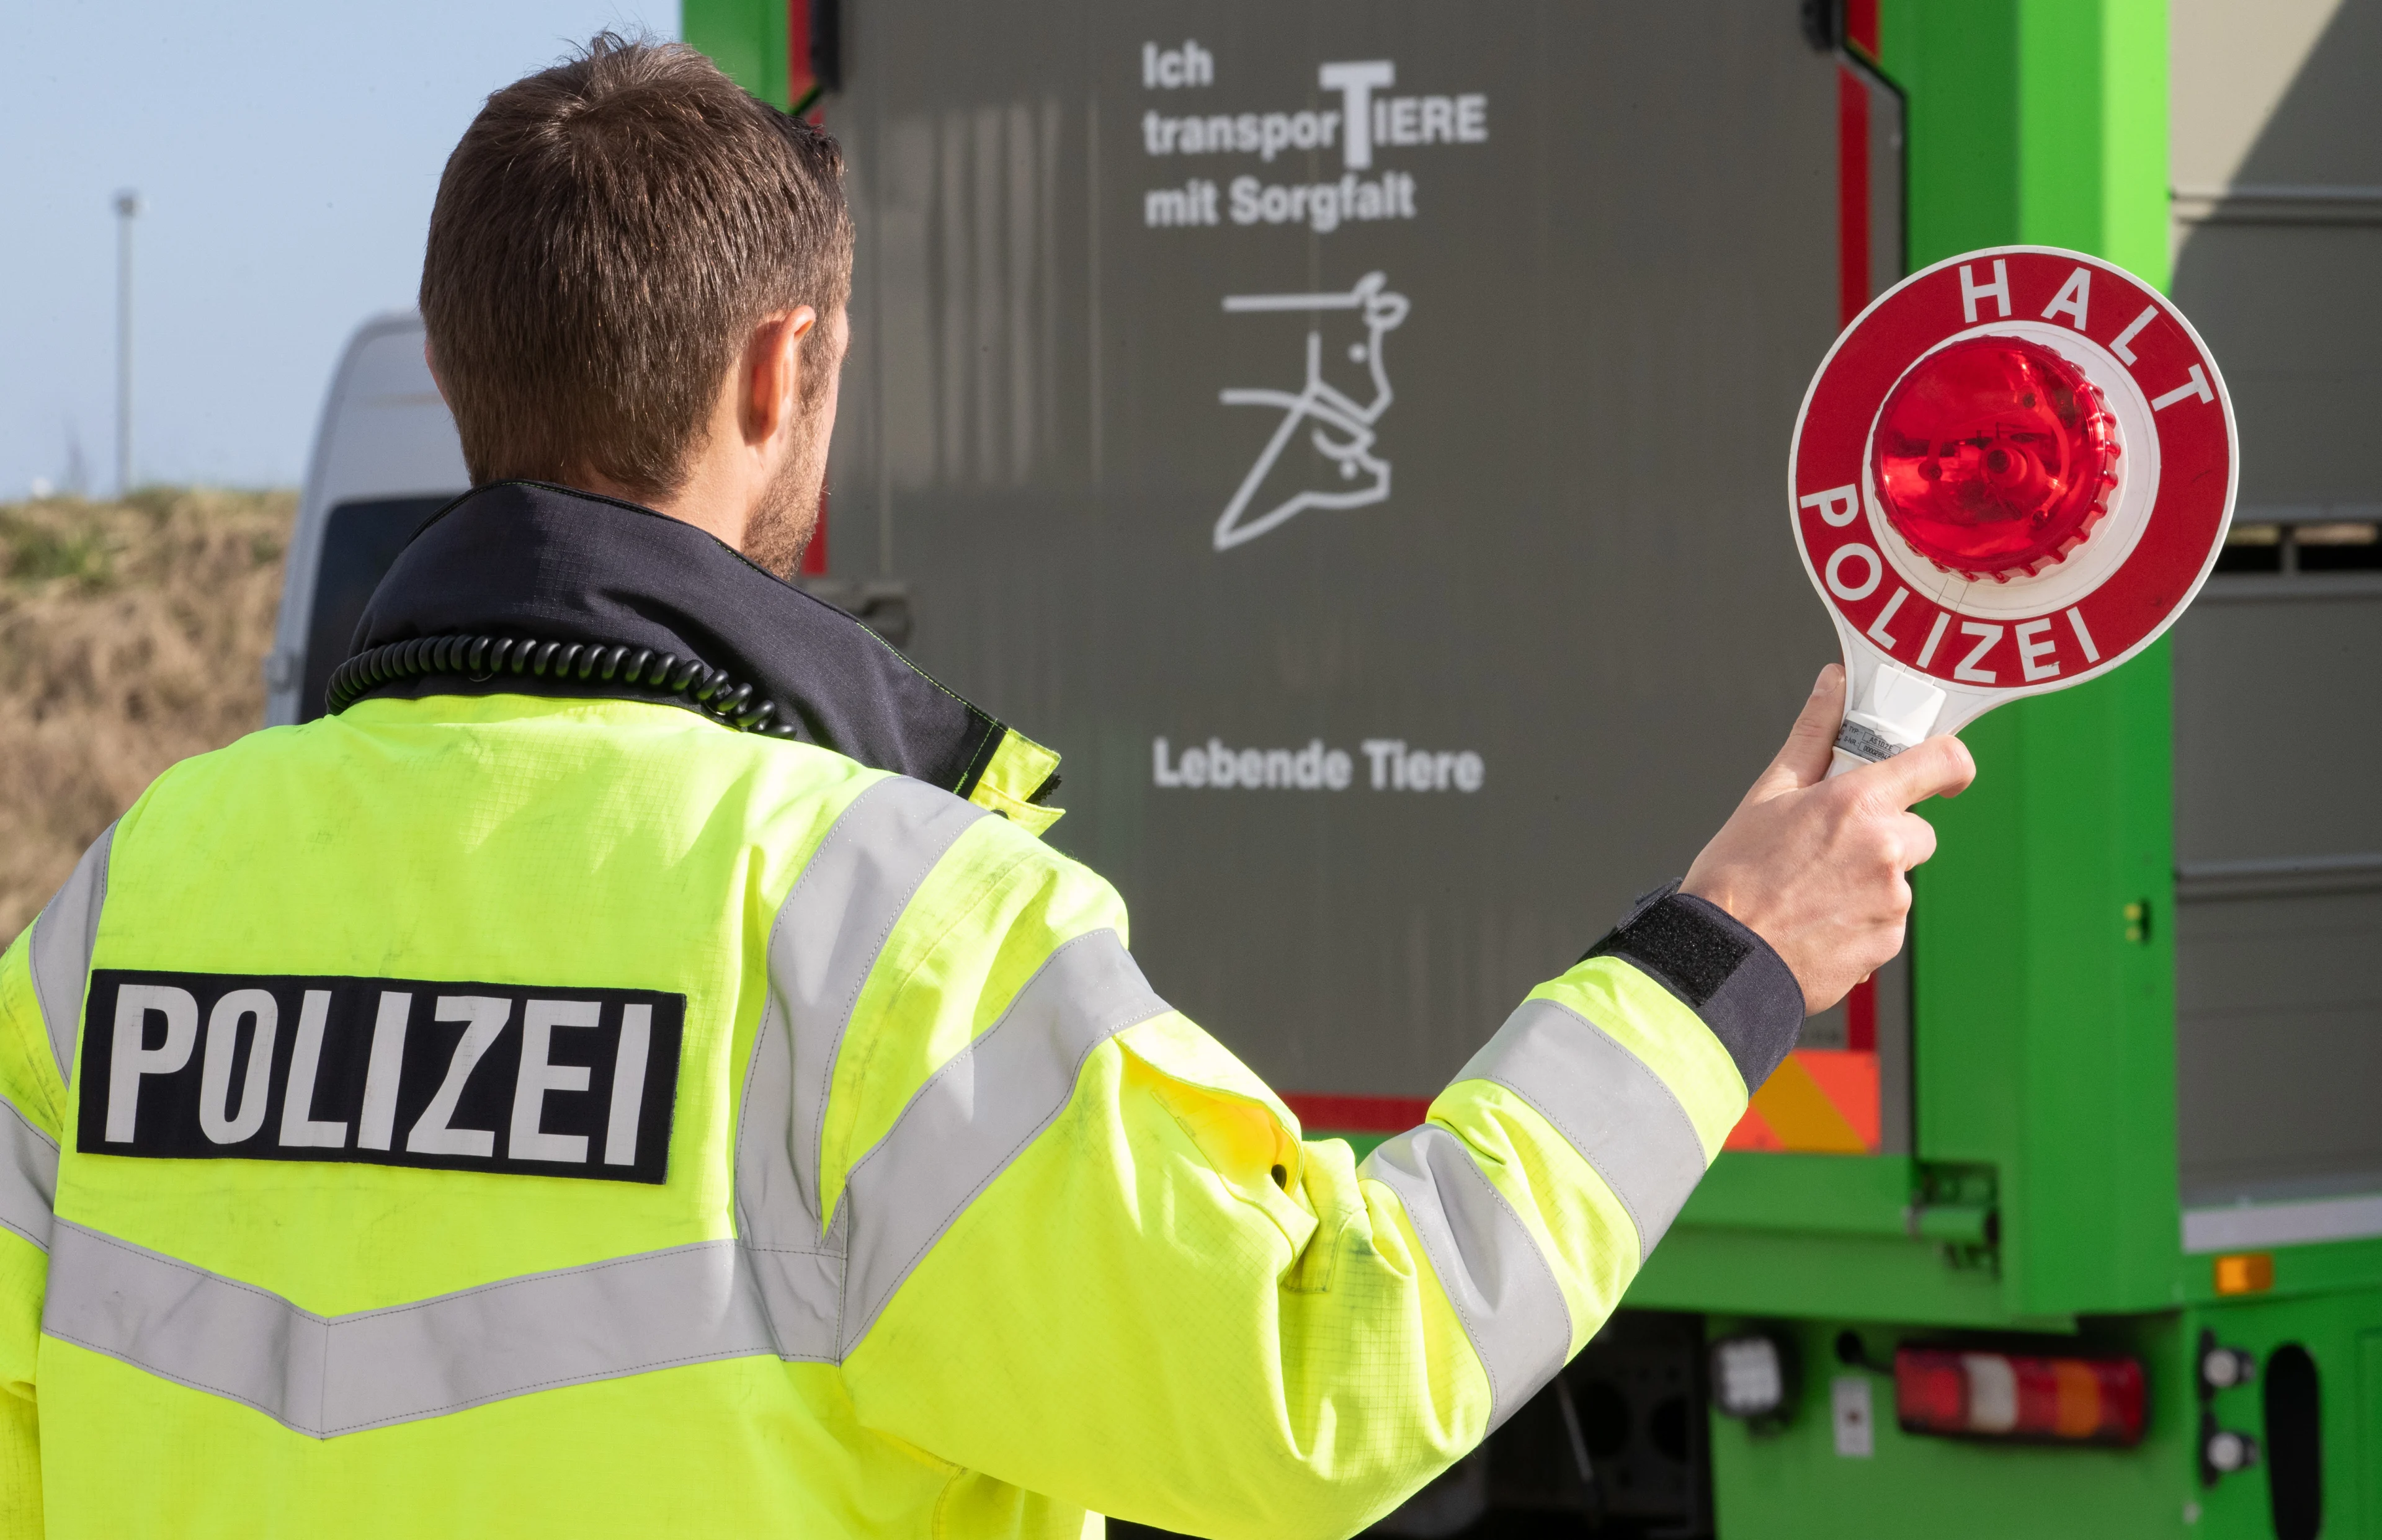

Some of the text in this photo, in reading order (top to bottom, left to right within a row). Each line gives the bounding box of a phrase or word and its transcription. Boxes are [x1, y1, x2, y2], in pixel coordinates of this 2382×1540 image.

[1143, 40, 1213, 88] Ich
[1143, 61, 1488, 169] transporTIERE
[1145, 171, 1416, 232] mit Sorgfalt
[1958, 258, 2215, 412] HALT
[1800, 483, 2102, 684] POLIZEI
[1153, 736, 1485, 792] Lebende Tiere
[105, 984, 653, 1166] POLIZEI
